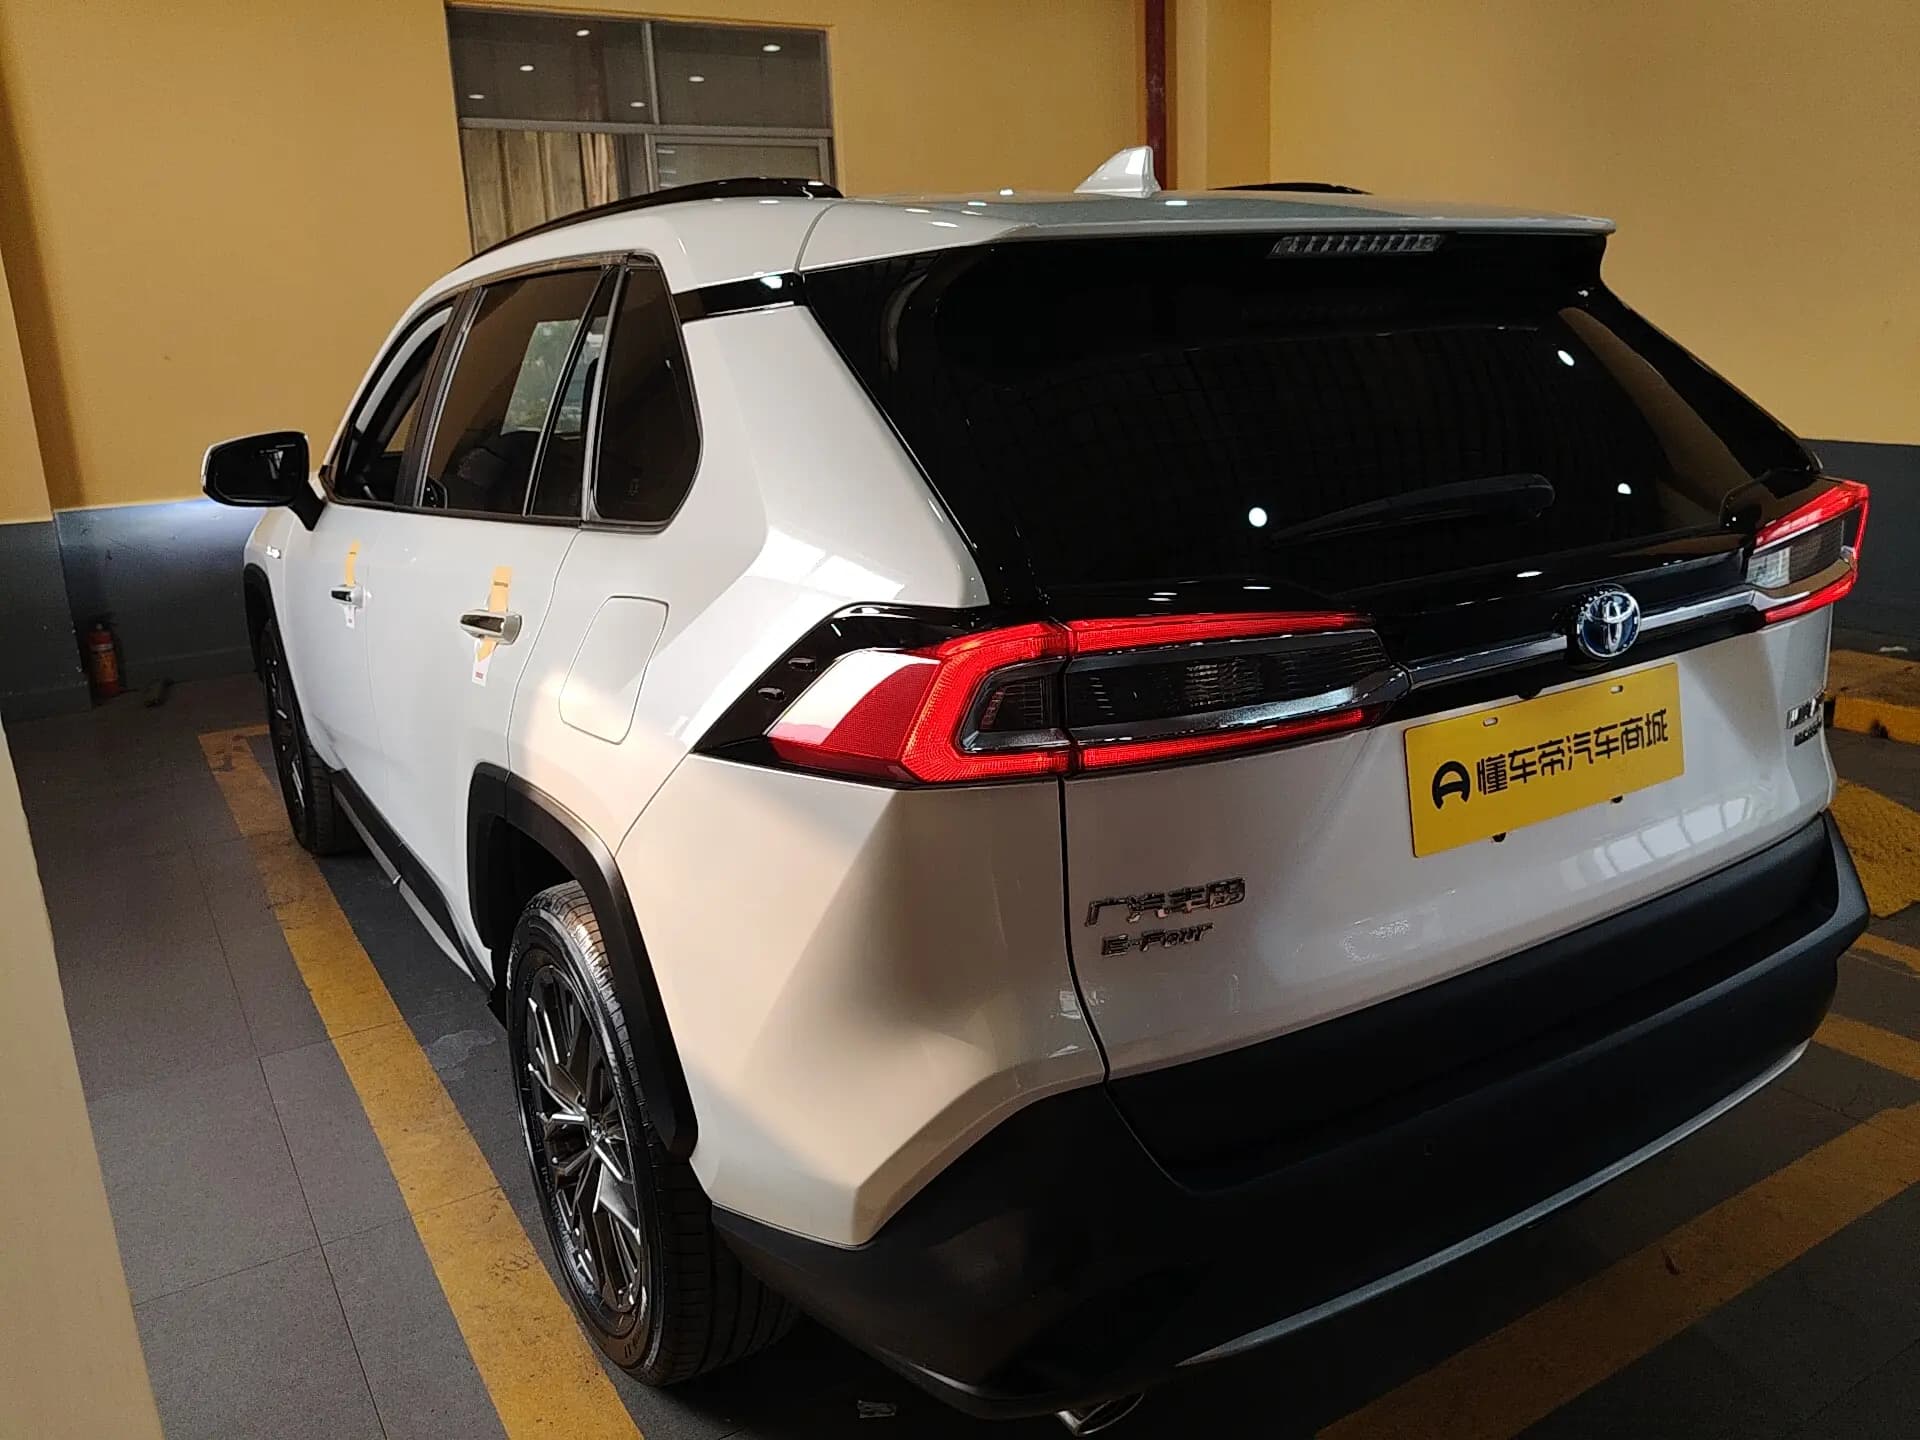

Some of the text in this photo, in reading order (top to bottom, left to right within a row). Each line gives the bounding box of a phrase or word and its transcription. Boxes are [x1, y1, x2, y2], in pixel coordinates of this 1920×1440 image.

[1476, 708, 1669, 795] 懂车帝汽车商城
[1085, 877, 1246, 926] 广汽丰田
[1101, 922, 1214, 956] E-Four
